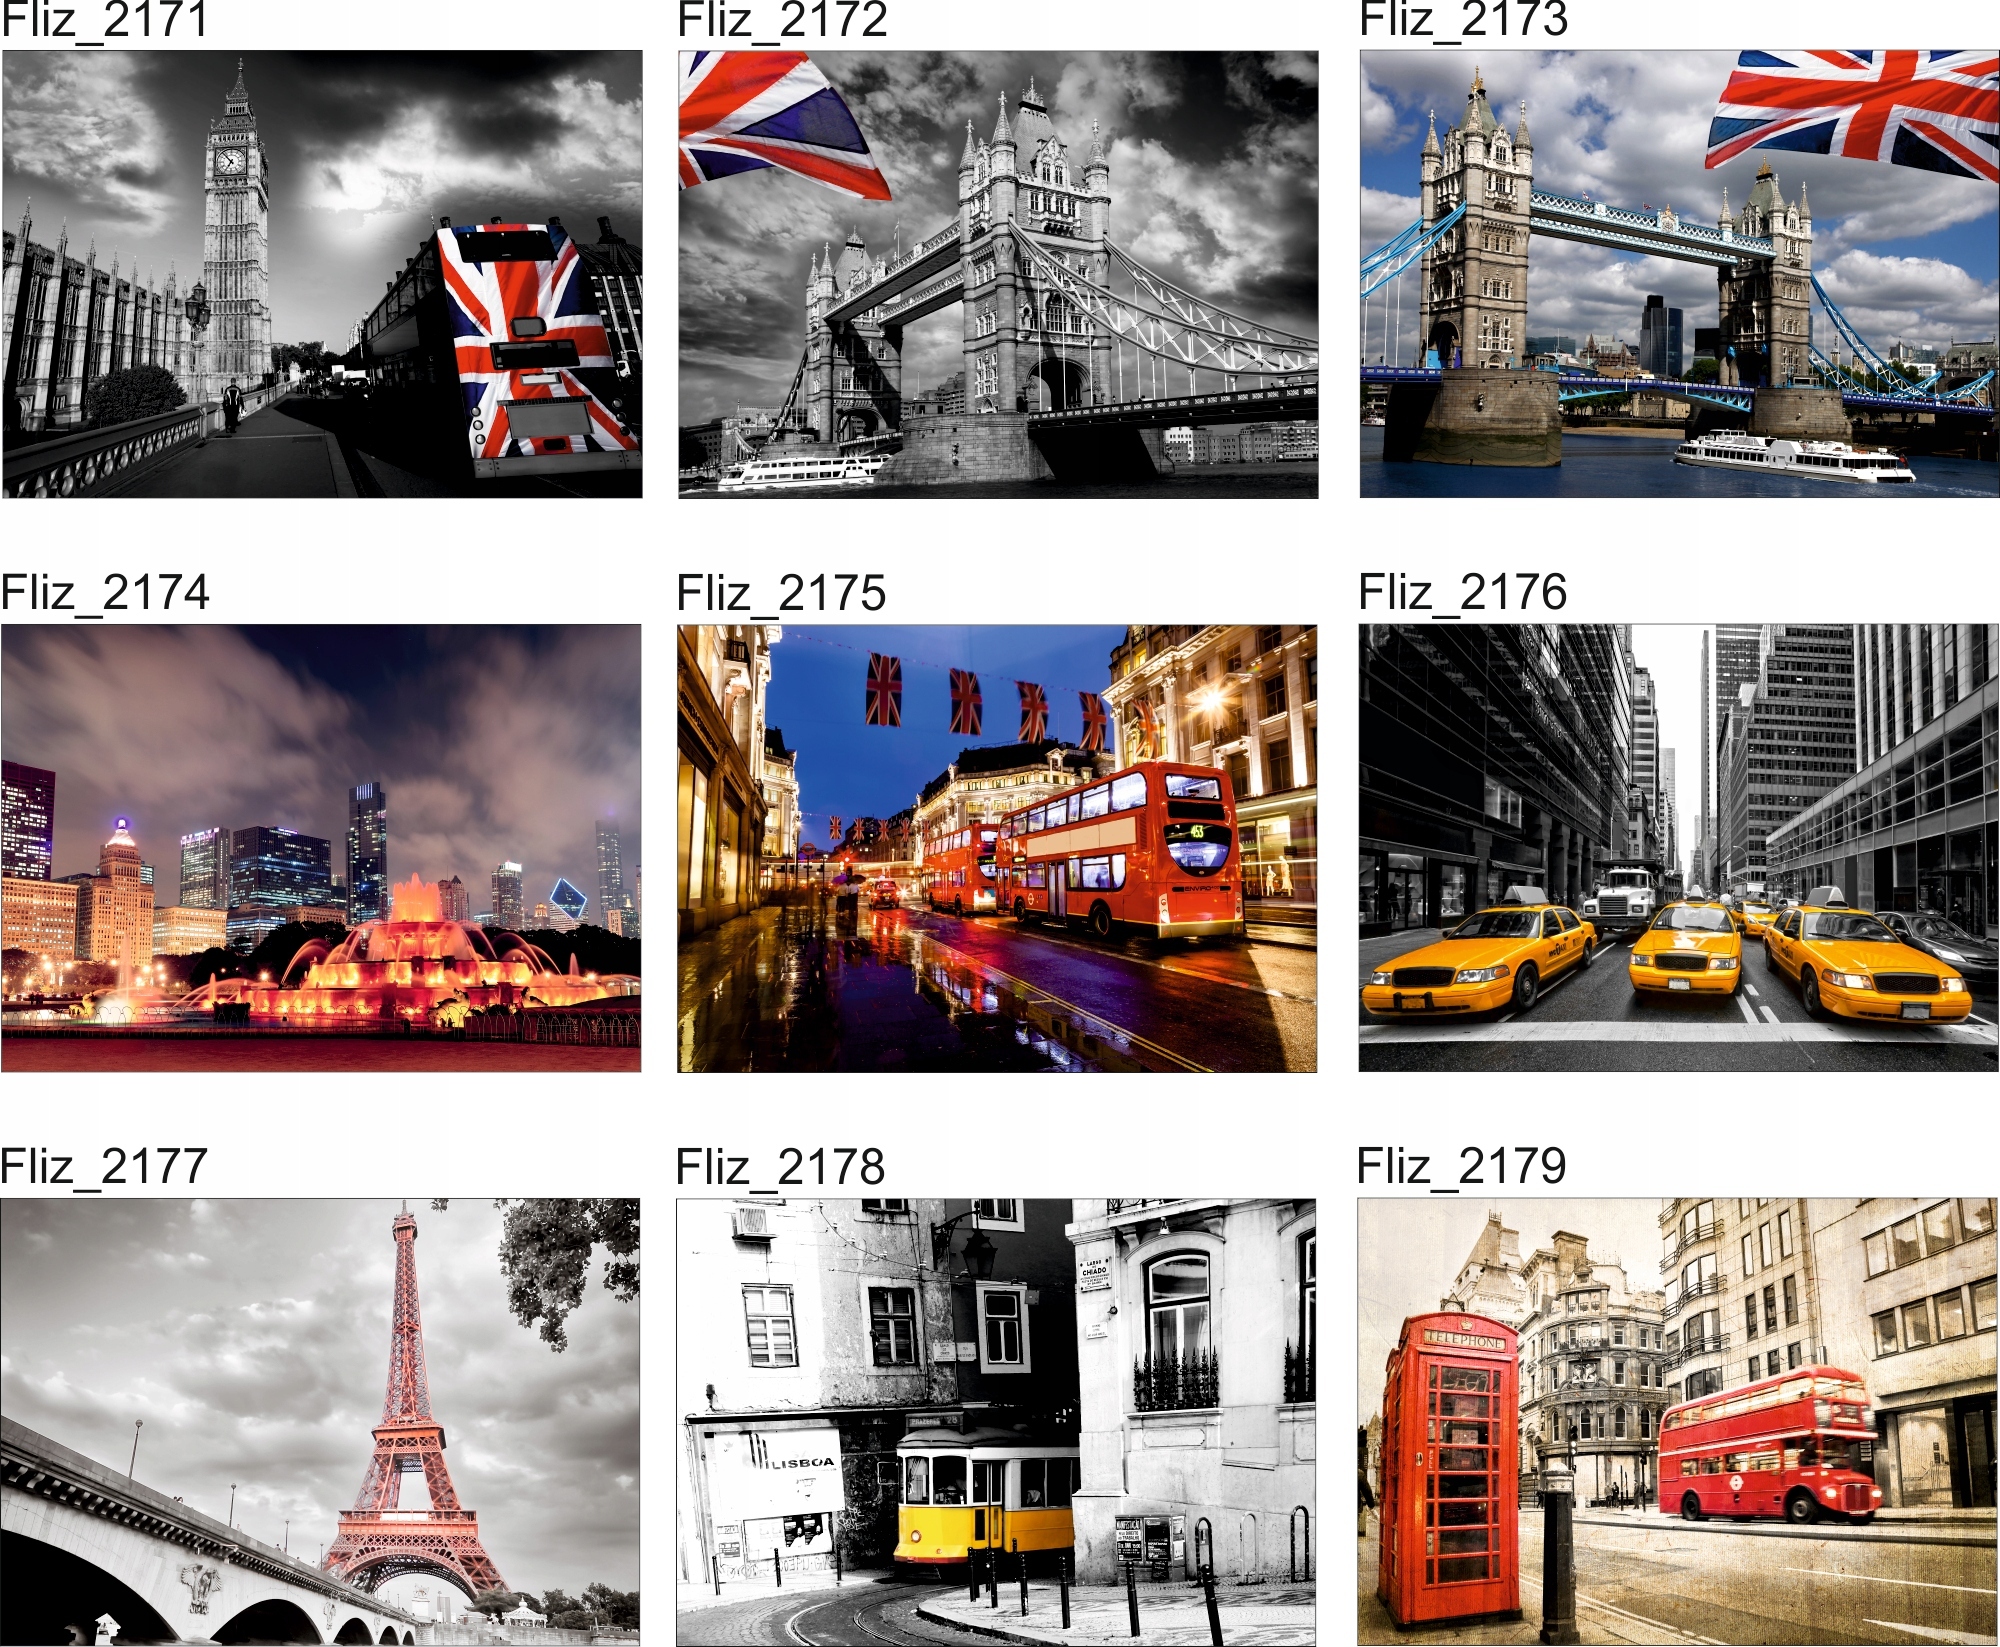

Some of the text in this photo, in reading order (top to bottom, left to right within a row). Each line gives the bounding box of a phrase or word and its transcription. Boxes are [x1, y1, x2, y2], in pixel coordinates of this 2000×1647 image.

[1190, 825, 1204, 838] 453
[1082, 1267, 1107, 1276] CHIADO
[1427, 1330, 1502, 1349] TELEPHONE
[946, 1416, 958, 1424] 28
[771, 1458, 835, 1470] LISBOA
